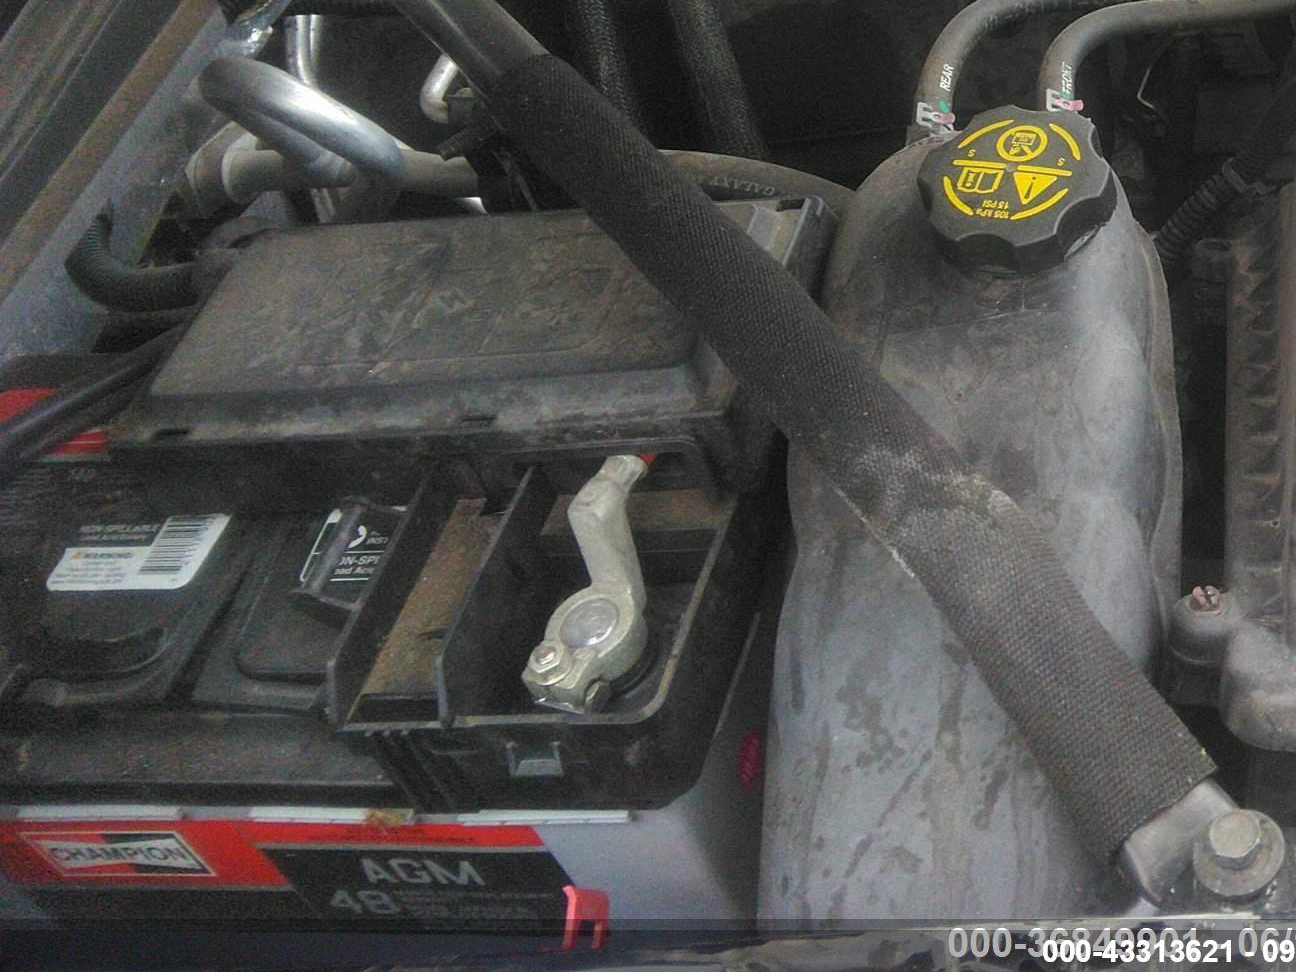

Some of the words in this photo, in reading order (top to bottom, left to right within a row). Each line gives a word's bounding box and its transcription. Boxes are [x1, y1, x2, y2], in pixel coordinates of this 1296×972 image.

[939, 63, 954, 91] REAR
[710, 175, 775, 197] GALAXY
[982, 199, 997, 209] PSI
[997, 199, 1009, 209] 15
[49, 846, 190, 862] CHAMPION
[360, 857, 486, 886] AGM
